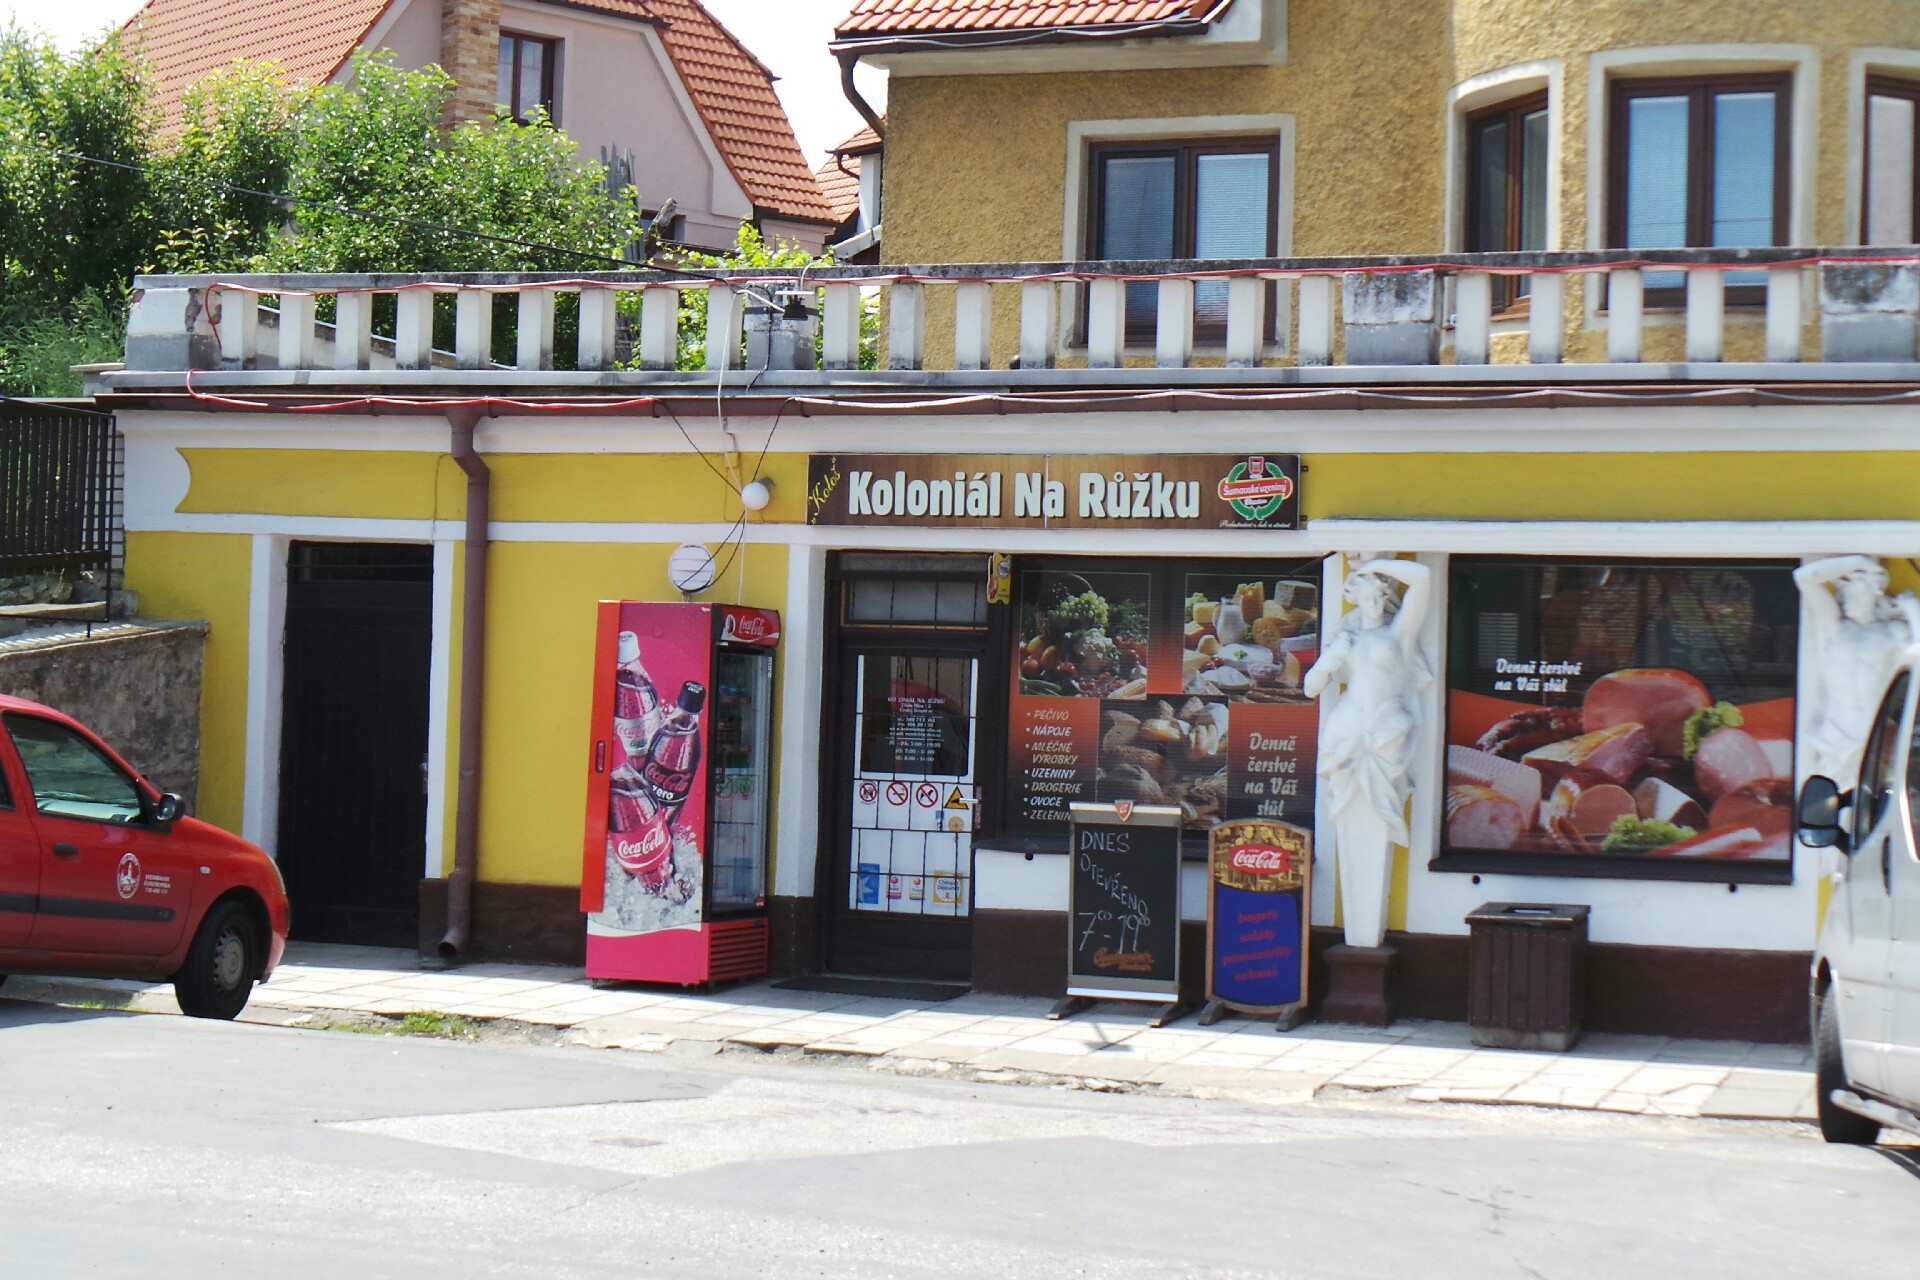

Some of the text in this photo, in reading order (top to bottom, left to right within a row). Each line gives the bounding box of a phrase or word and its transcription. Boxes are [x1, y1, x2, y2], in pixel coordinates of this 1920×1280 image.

[848, 470, 1200, 518] Koloniál Na Růžku
[1496, 658, 1583, 676] Denně čerstvé
[1494, 676, 1569, 693] na Váš stůl
[1033, 709, 1070, 721] PEČIVO
[1032, 724, 1072, 737] NÁPOJE
[1031, 740, 1073, 753] MLÉČNÉ
[1249, 732, 1298, 751] Denně
[1031, 767, 1076, 779] UZENINY
[1247, 756, 1298, 773] čerstvé
[1031, 781, 1083, 794] DROGERIE
[1244, 776, 1299, 796] na Váš
[1030, 795, 1063, 807] OVOCE
[1257, 799, 1285, 817] stůl
[1030, 809, 1071, 821] ZELENIN
[617, 826, 666, 860] Coca-Cola
[1080, 830, 1130, 853] DNES
[1232, 849, 1283, 870] Coca-Cola
[1080, 853, 1148, 917] OTEVŘENO
